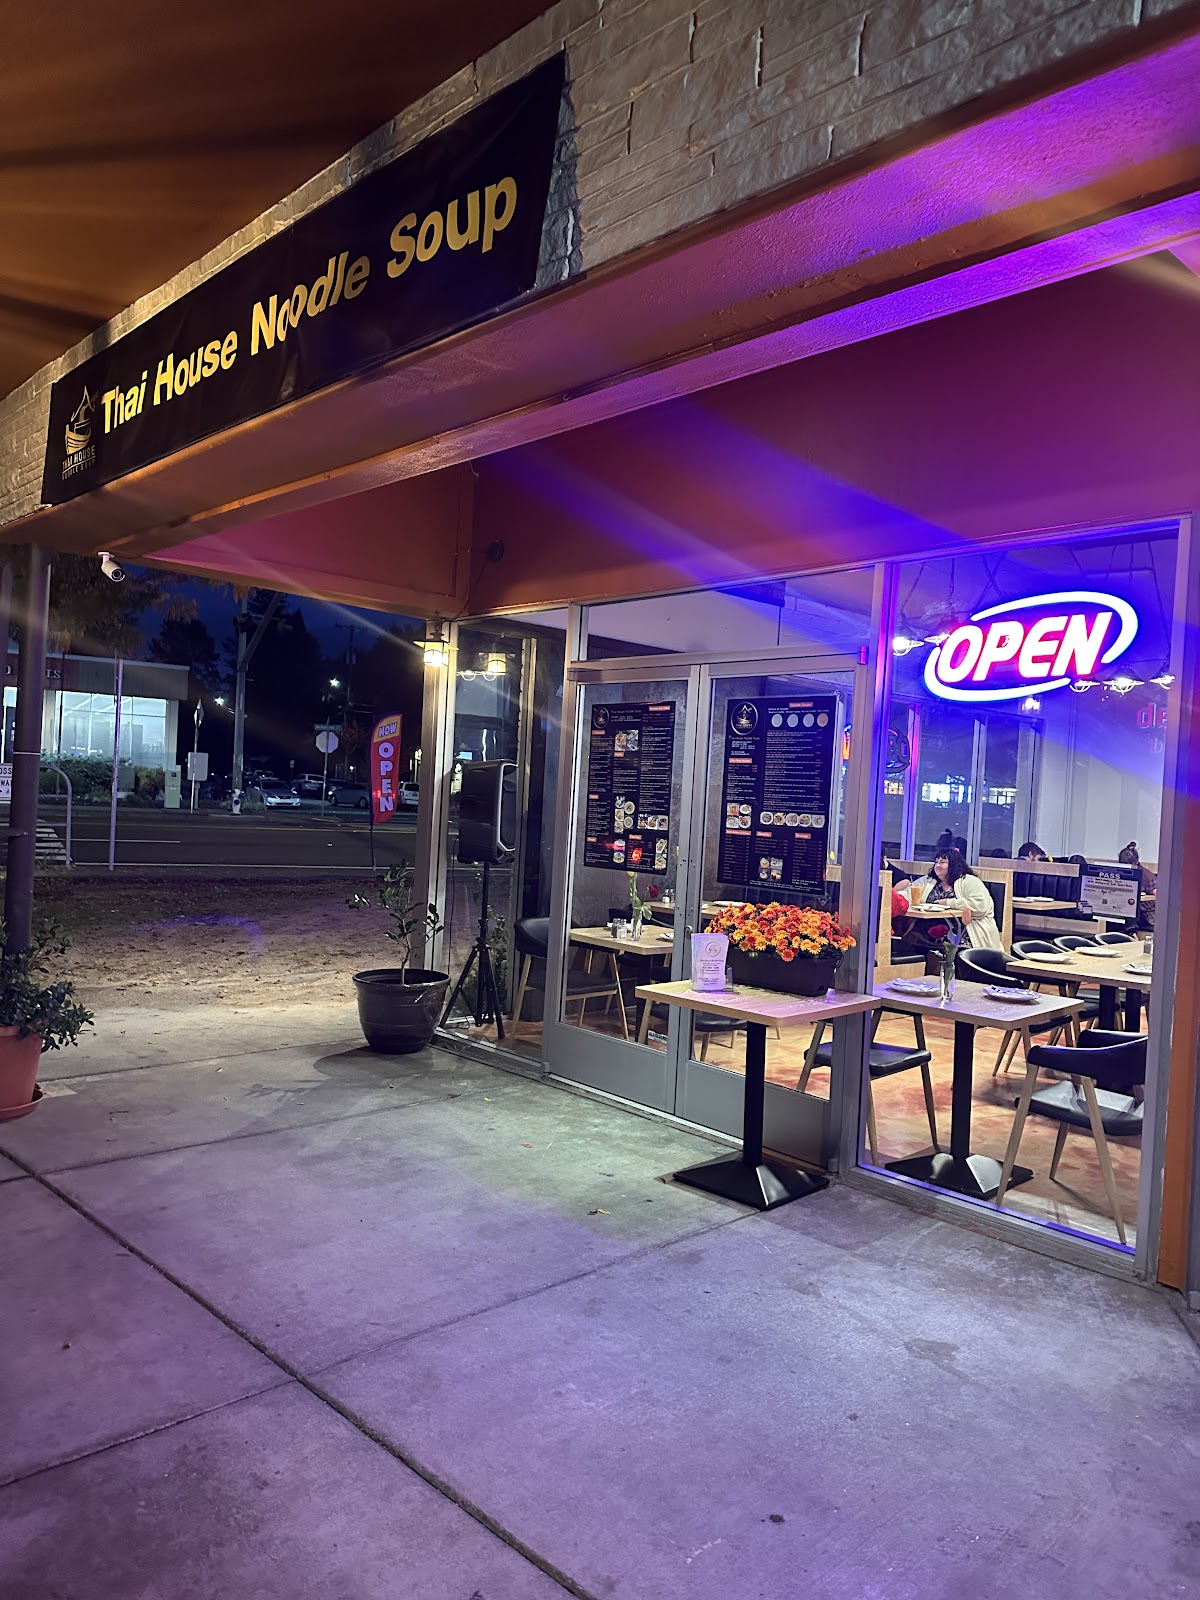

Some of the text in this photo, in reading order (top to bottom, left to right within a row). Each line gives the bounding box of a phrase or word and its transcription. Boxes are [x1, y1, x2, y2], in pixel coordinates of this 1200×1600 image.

[101, 176, 517, 434] Thai House Noodle Soup
[74, 445, 96, 463] HOUSE
[937, 612, 1112, 682] OPEN
[378, 723, 397, 737] NOW
[378, 742, 395, 812] OPEN
[1099, 871, 1121, 880] PASS
